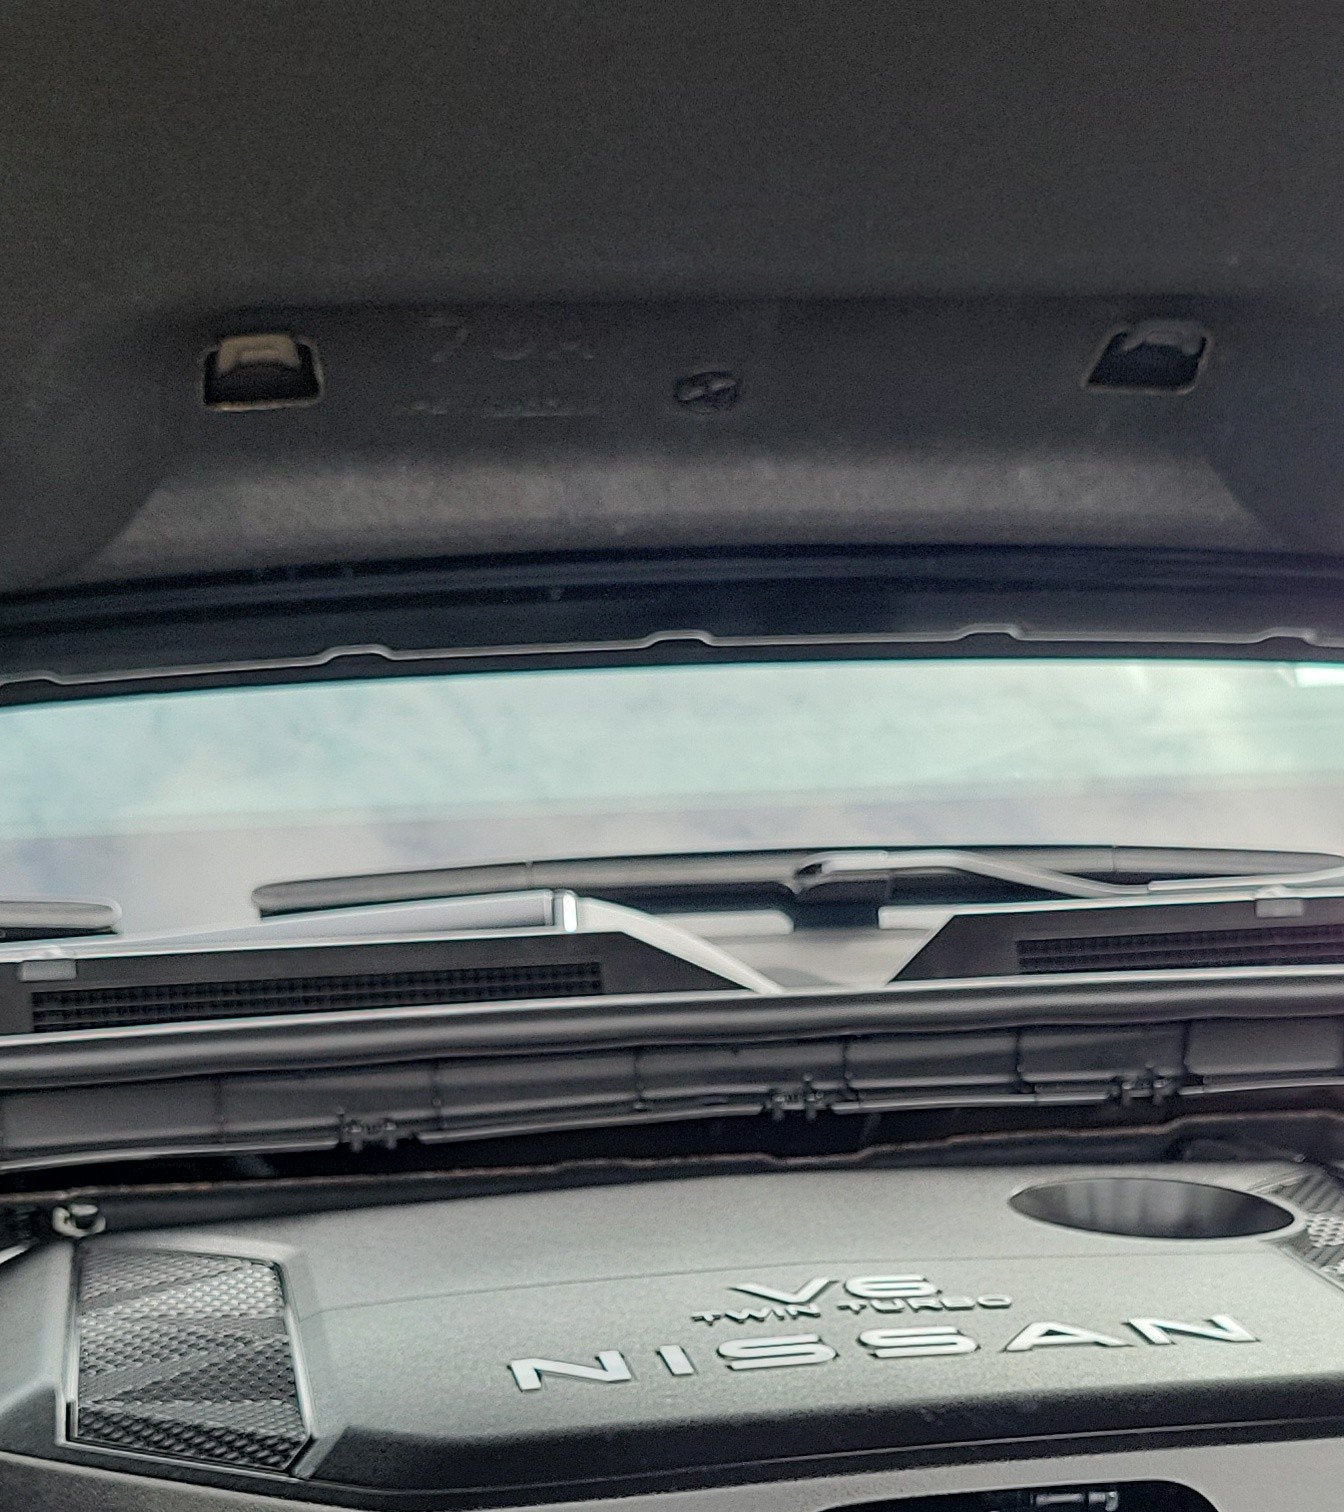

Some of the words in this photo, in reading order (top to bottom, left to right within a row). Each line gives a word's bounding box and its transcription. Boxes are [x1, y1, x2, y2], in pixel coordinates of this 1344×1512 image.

[727, 1274, 942, 1306] V6
[691, 1303, 821, 1325] TWIN
[837, 1294, 1012, 1314] TURBO
[507, 1313, 1260, 1392] NISSAN
